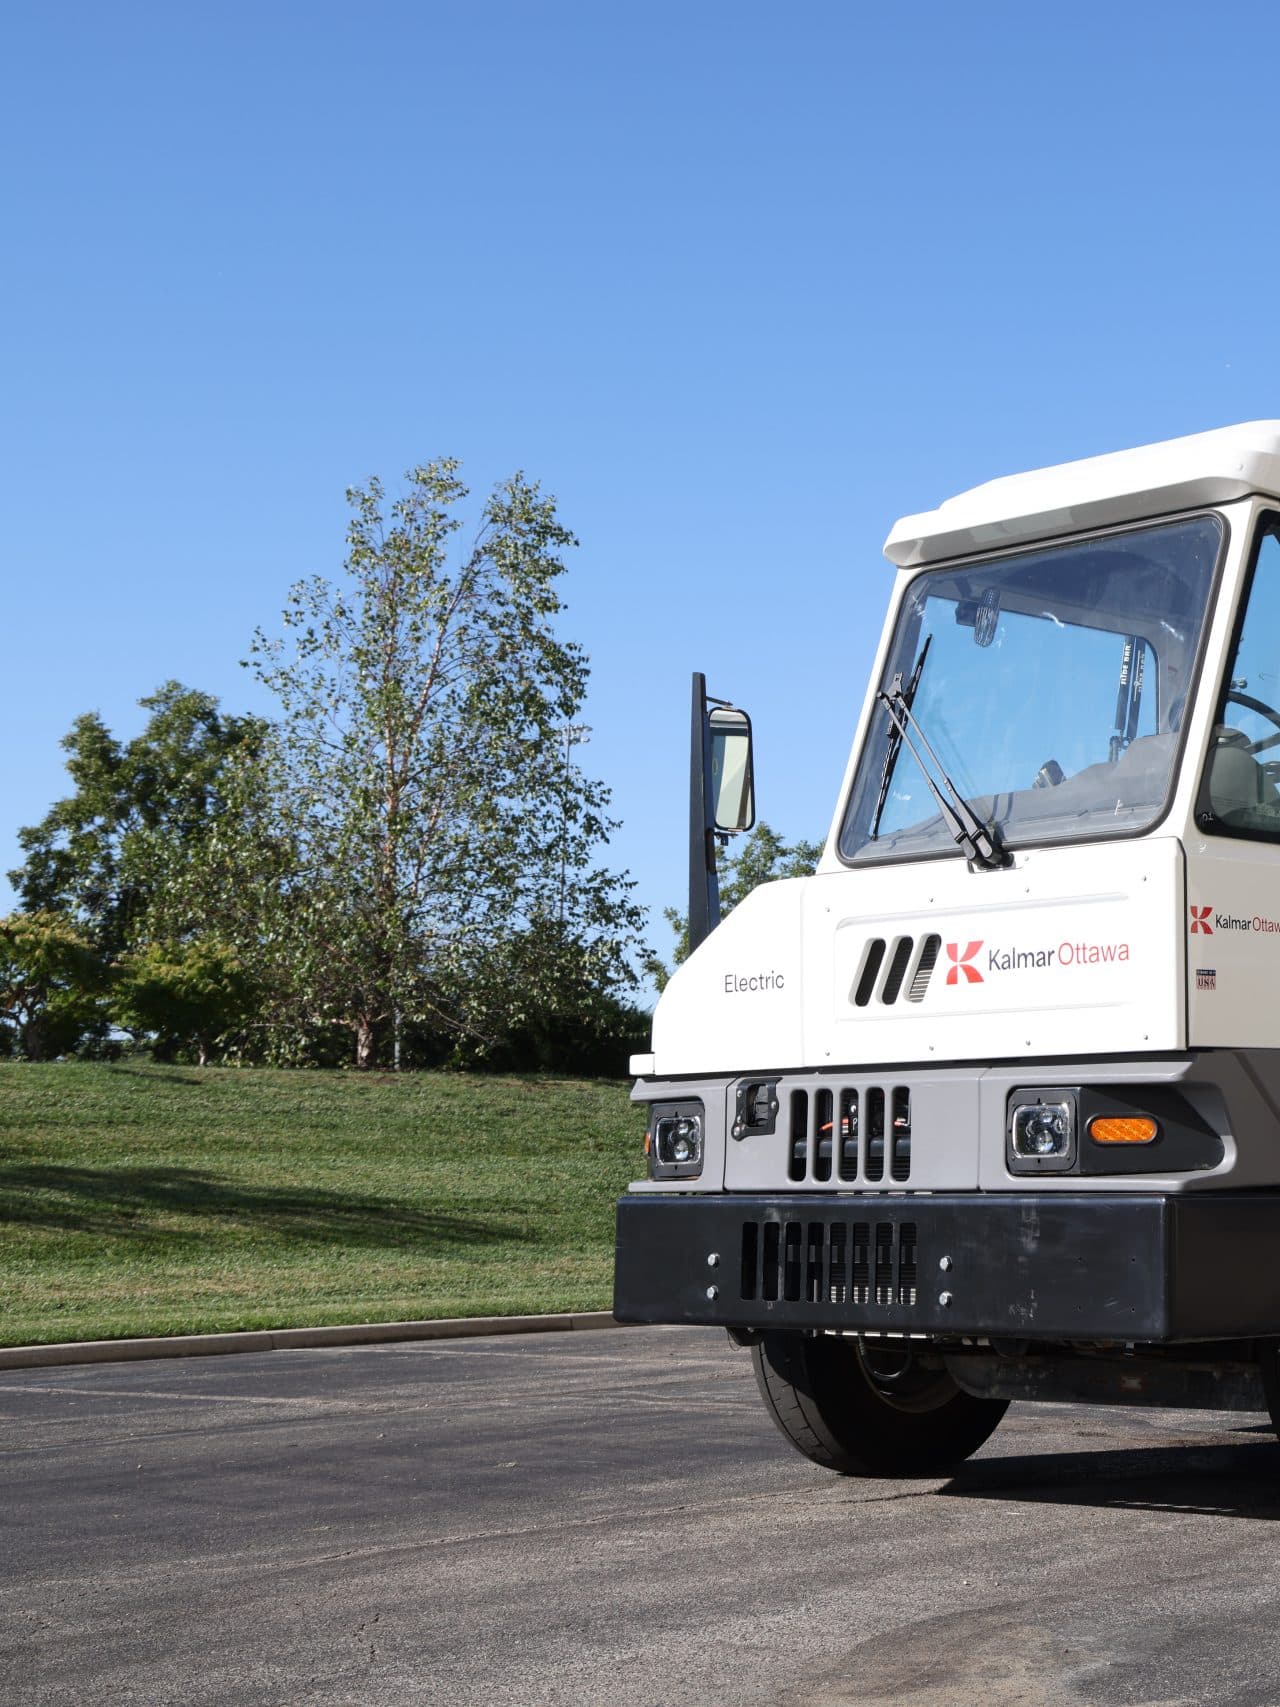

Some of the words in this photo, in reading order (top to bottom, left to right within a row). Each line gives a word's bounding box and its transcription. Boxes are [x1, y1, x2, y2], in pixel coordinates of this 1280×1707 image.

[1215, 914, 1251, 930] Kalmar
[989, 947, 1055, 971] Kalmar
[1058, 942, 1129, 966] Ottawa
[725, 970, 784, 992] Electric
[1198, 978, 1215, 987] USA
